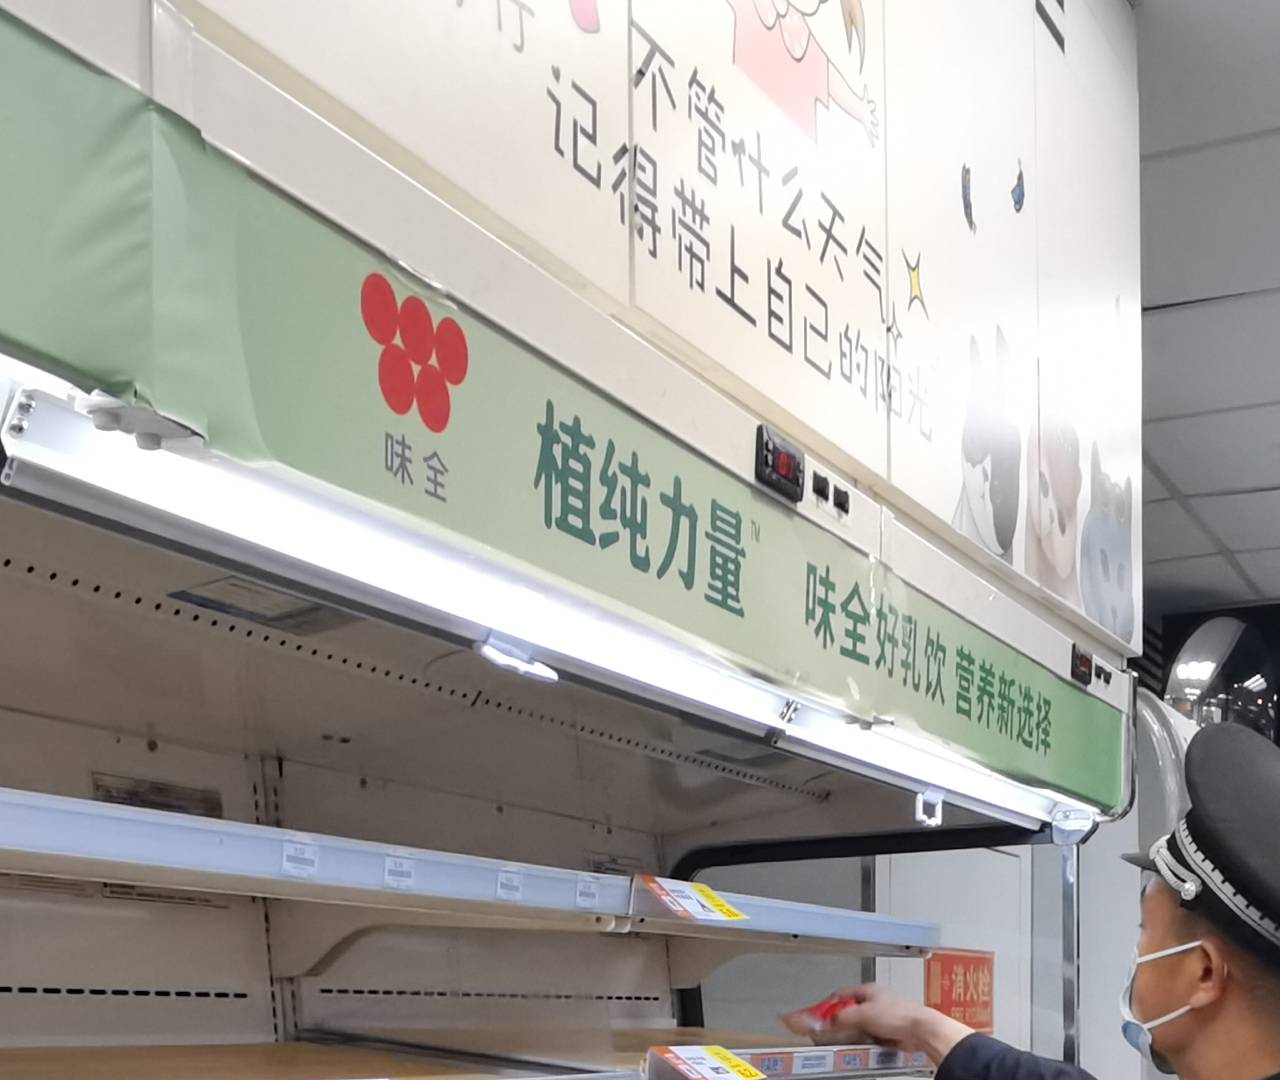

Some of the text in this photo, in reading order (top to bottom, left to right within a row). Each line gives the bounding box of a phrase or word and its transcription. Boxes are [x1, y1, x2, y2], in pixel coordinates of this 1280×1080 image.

[630, 19, 886, 323] 不管什么天气
[384, 431, 449, 503] 味全
[533, 399, 746, 618] 植纯力量
[805, 561, 1052, 756] 味全好乳饮 营养新选择
[951, 963, 992, 1001] 消火栓
